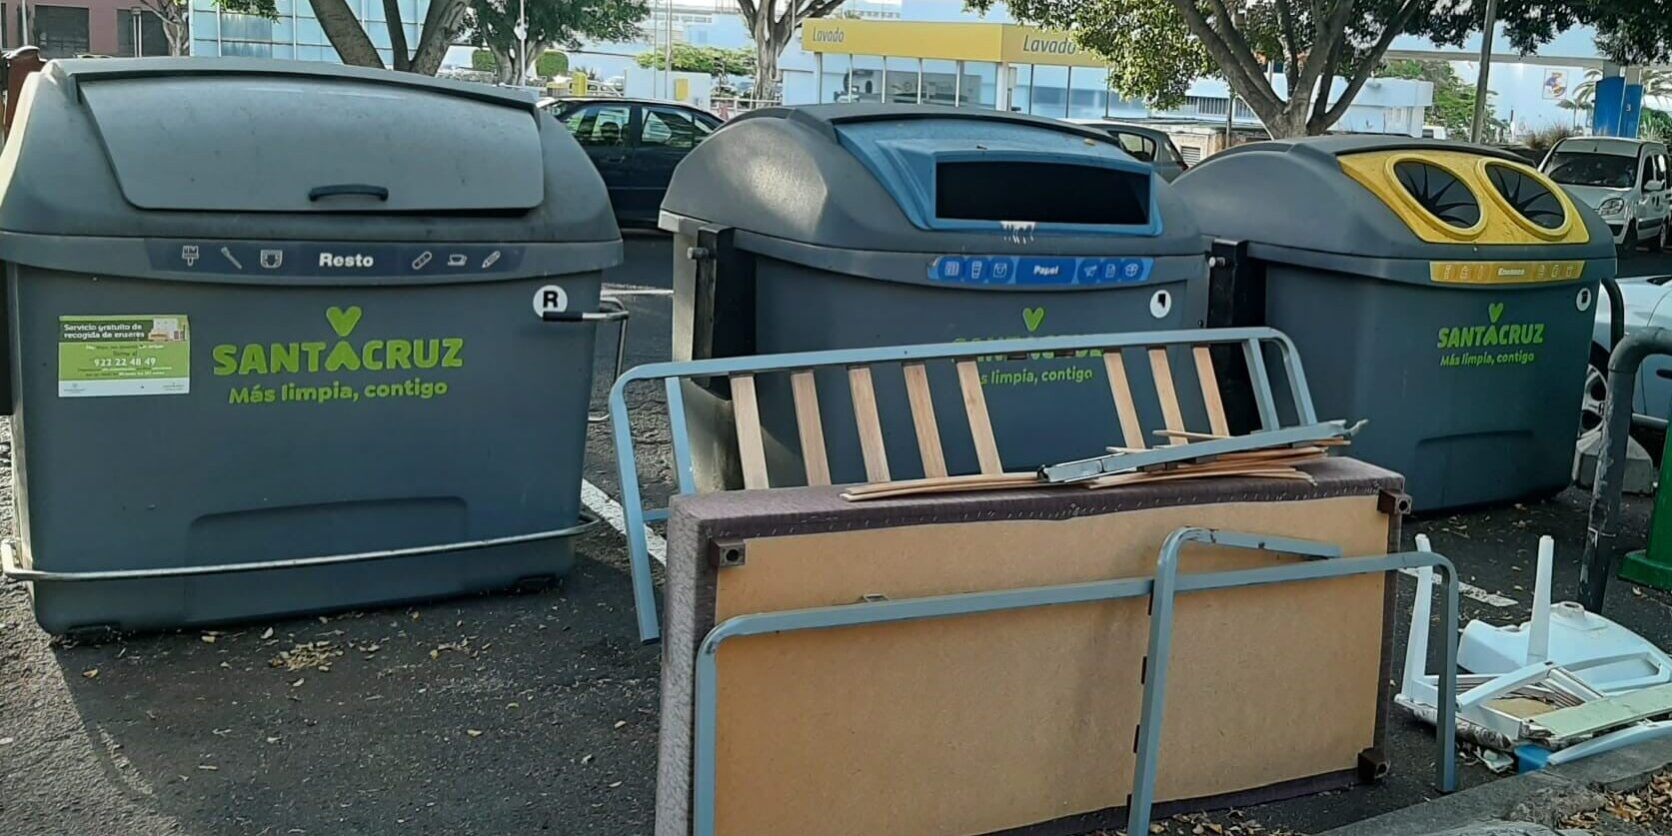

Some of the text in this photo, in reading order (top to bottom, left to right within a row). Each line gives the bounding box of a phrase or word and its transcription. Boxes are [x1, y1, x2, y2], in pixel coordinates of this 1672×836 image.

[812, 27, 844, 43] Lavado
[1023, 34, 1076, 54] Lavado
[319, 252, 374, 267] Resto
[1033, 265, 1059, 277] Papel
[543, 290, 559, 308] R
[64, 323, 142, 332] Servicio gratuito de
[64, 331, 101, 340] recogida
[94, 358, 112, 367] 922
[114, 358, 127, 367] 22
[1440, 350, 1535, 366] Más limpia, contigo
[991, 368, 1038, 386] limpia,
[1041, 366, 1093, 384] contigo
[229, 377, 448, 404] Más limpia, contigo
